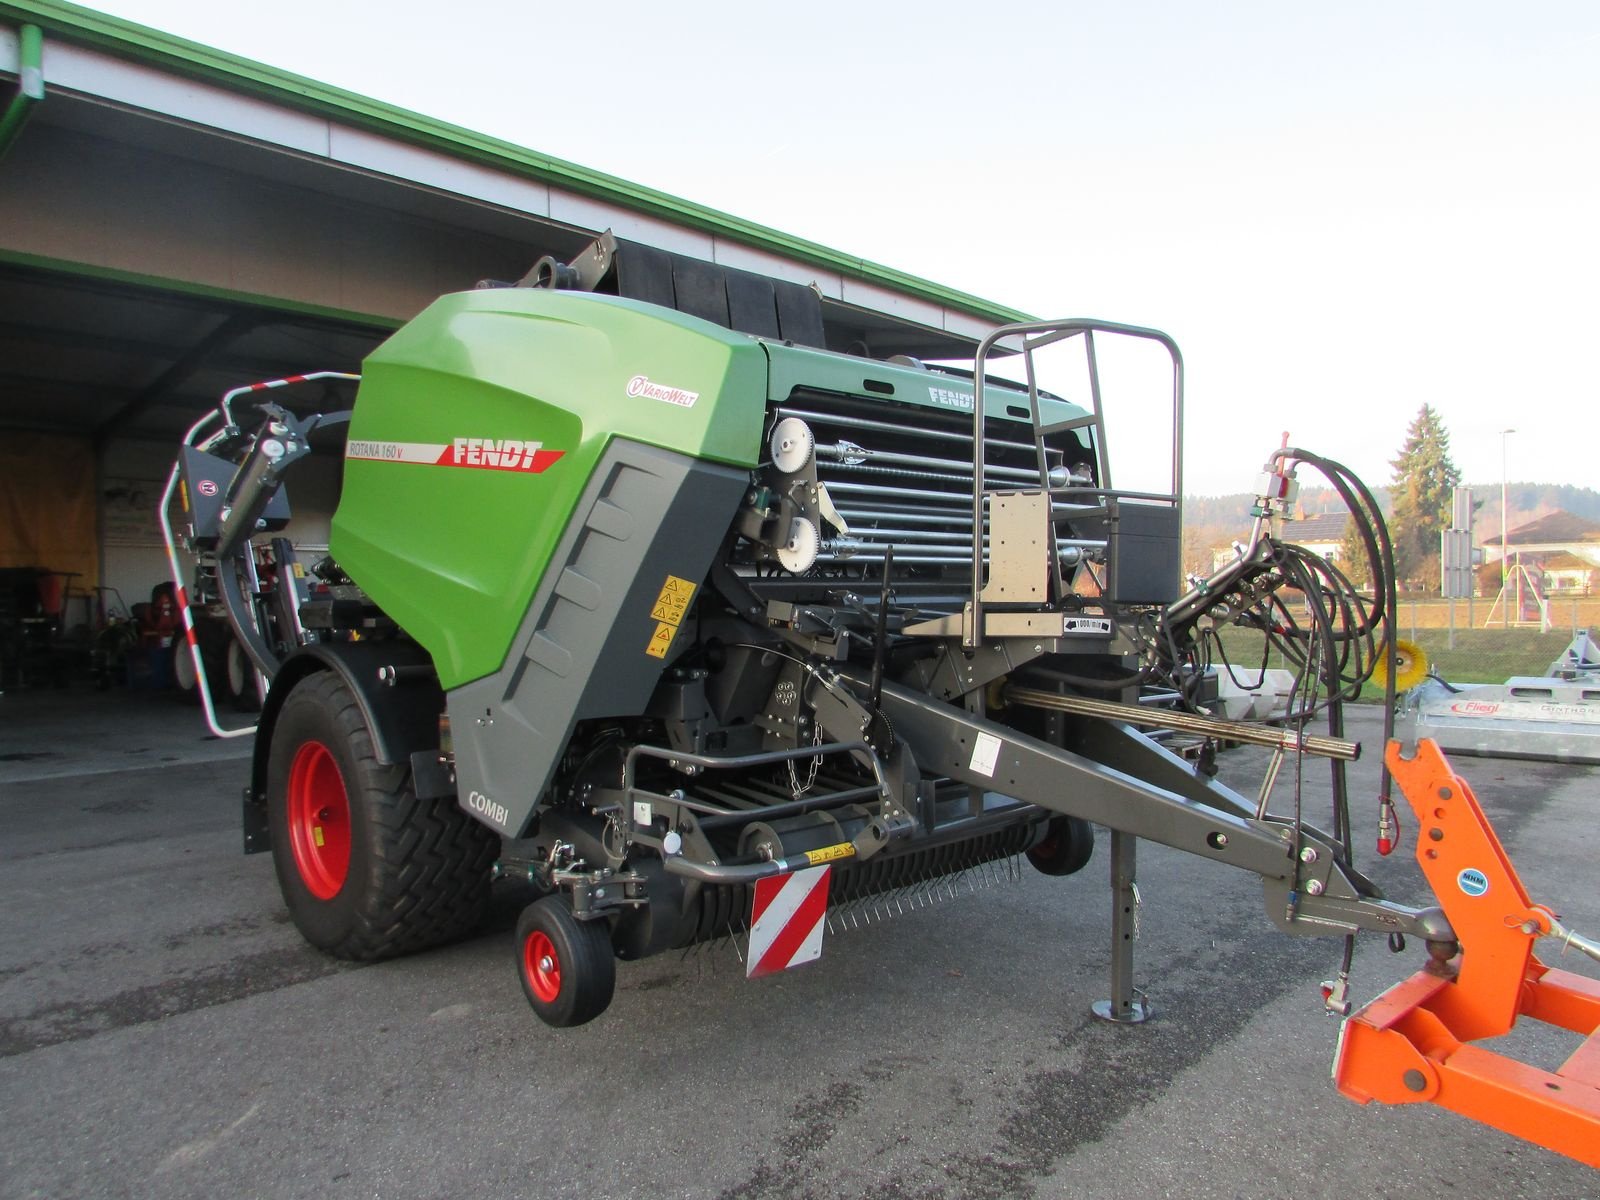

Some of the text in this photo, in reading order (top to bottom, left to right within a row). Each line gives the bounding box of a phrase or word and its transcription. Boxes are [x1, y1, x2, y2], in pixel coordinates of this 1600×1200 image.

[350, 442, 380, 457] ROTANA
[382, 445, 396, 458] 160
[454, 437, 543, 469] FENDT
[1465, 702, 1500, 714] Fliegl
[469, 790, 509, 826] COMBI
